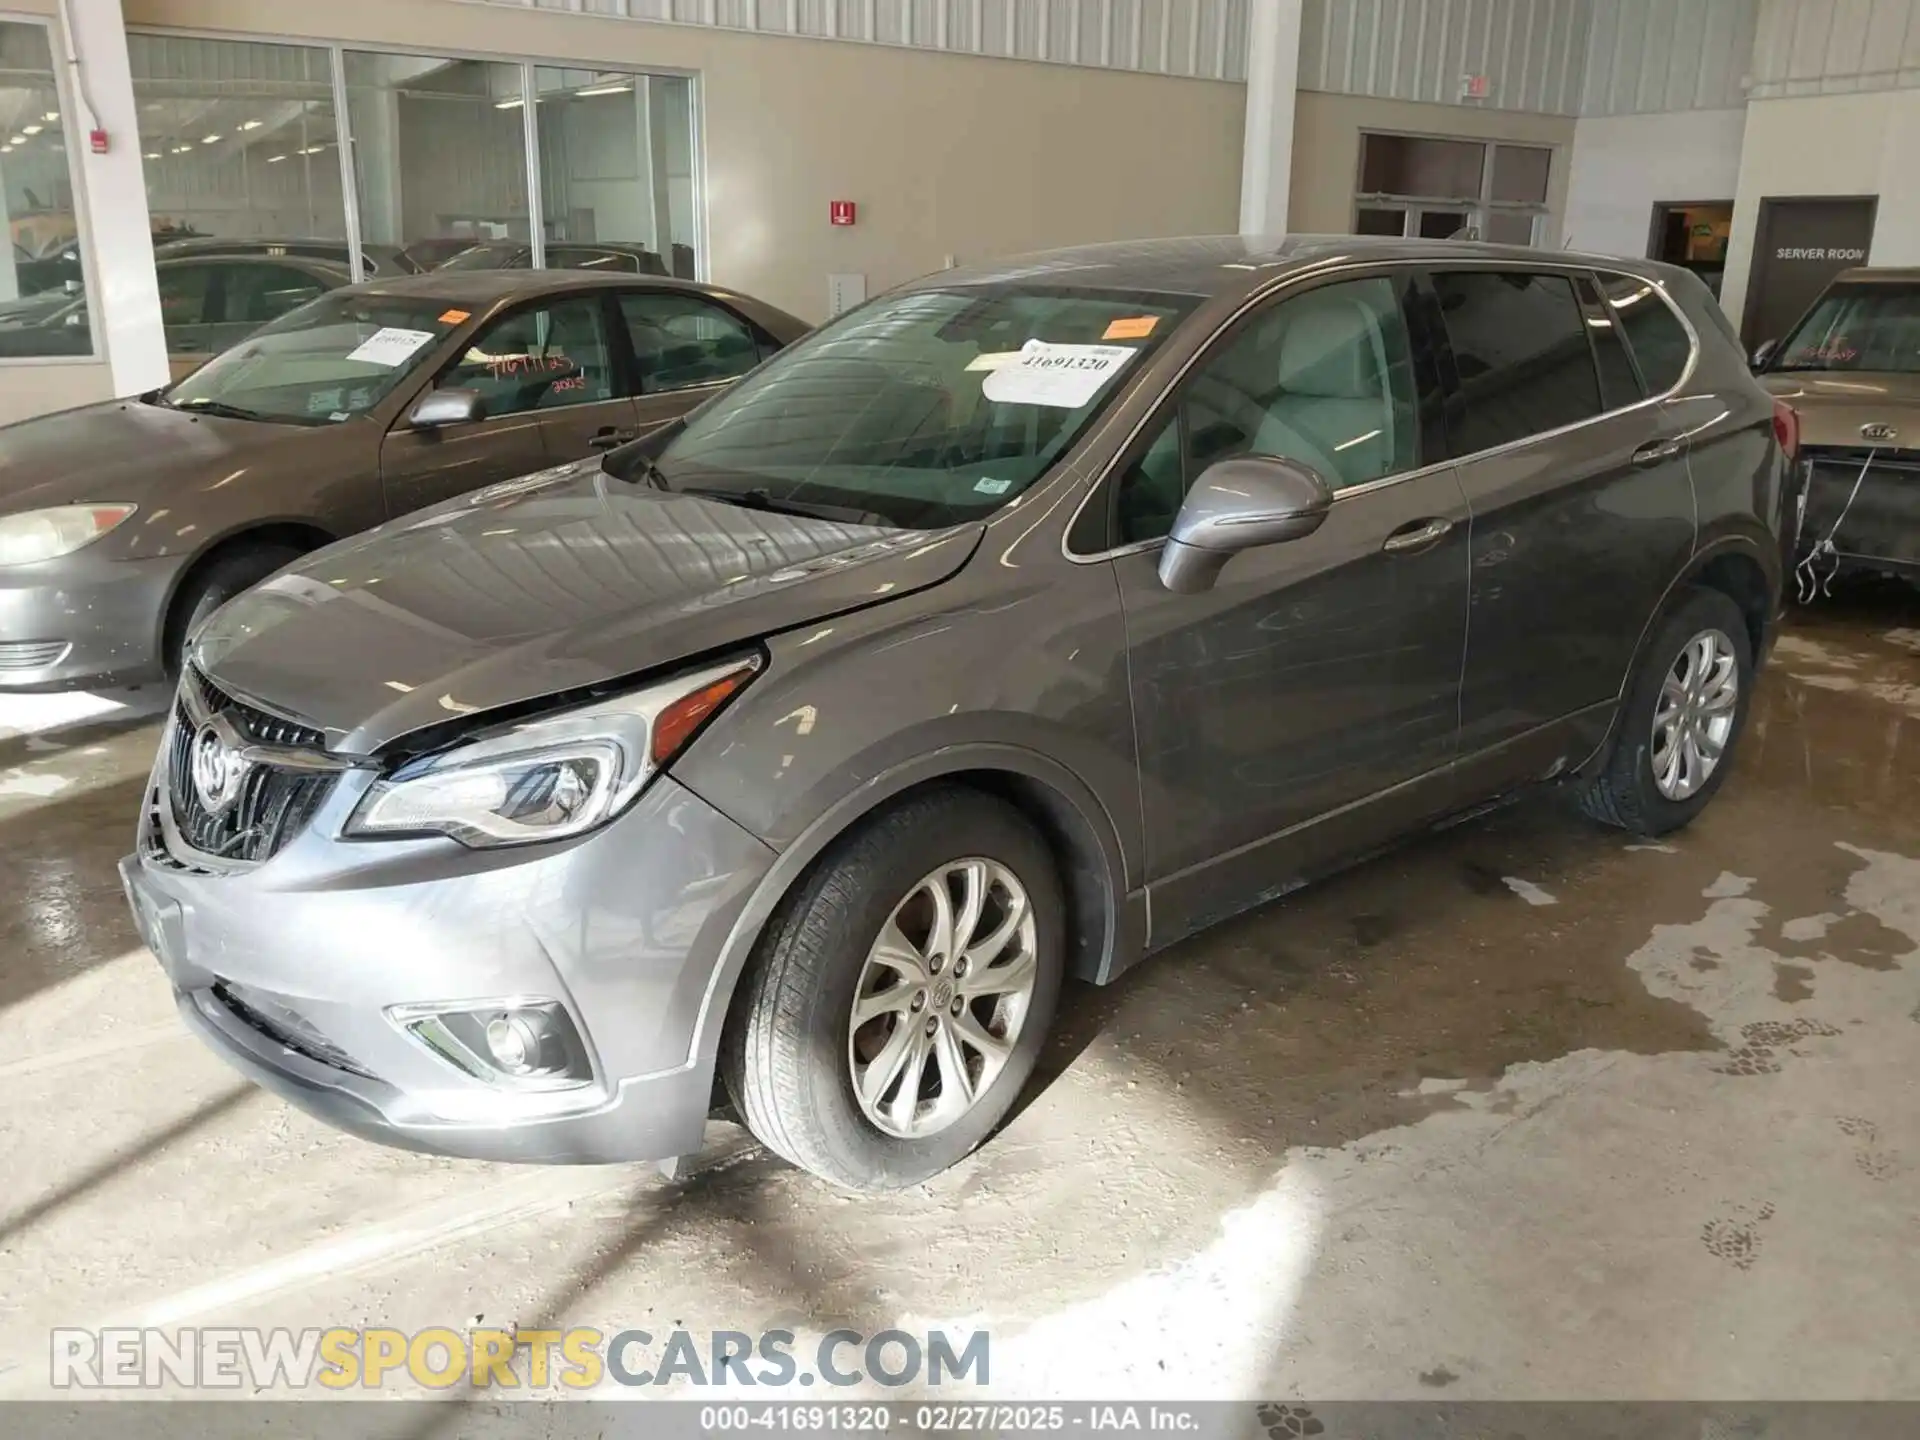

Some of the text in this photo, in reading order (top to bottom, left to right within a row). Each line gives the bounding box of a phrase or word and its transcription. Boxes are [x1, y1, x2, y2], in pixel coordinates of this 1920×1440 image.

[1776, 247, 1865, 260] SERVER ROOM
[1022, 355, 1110, 371] 41691320
